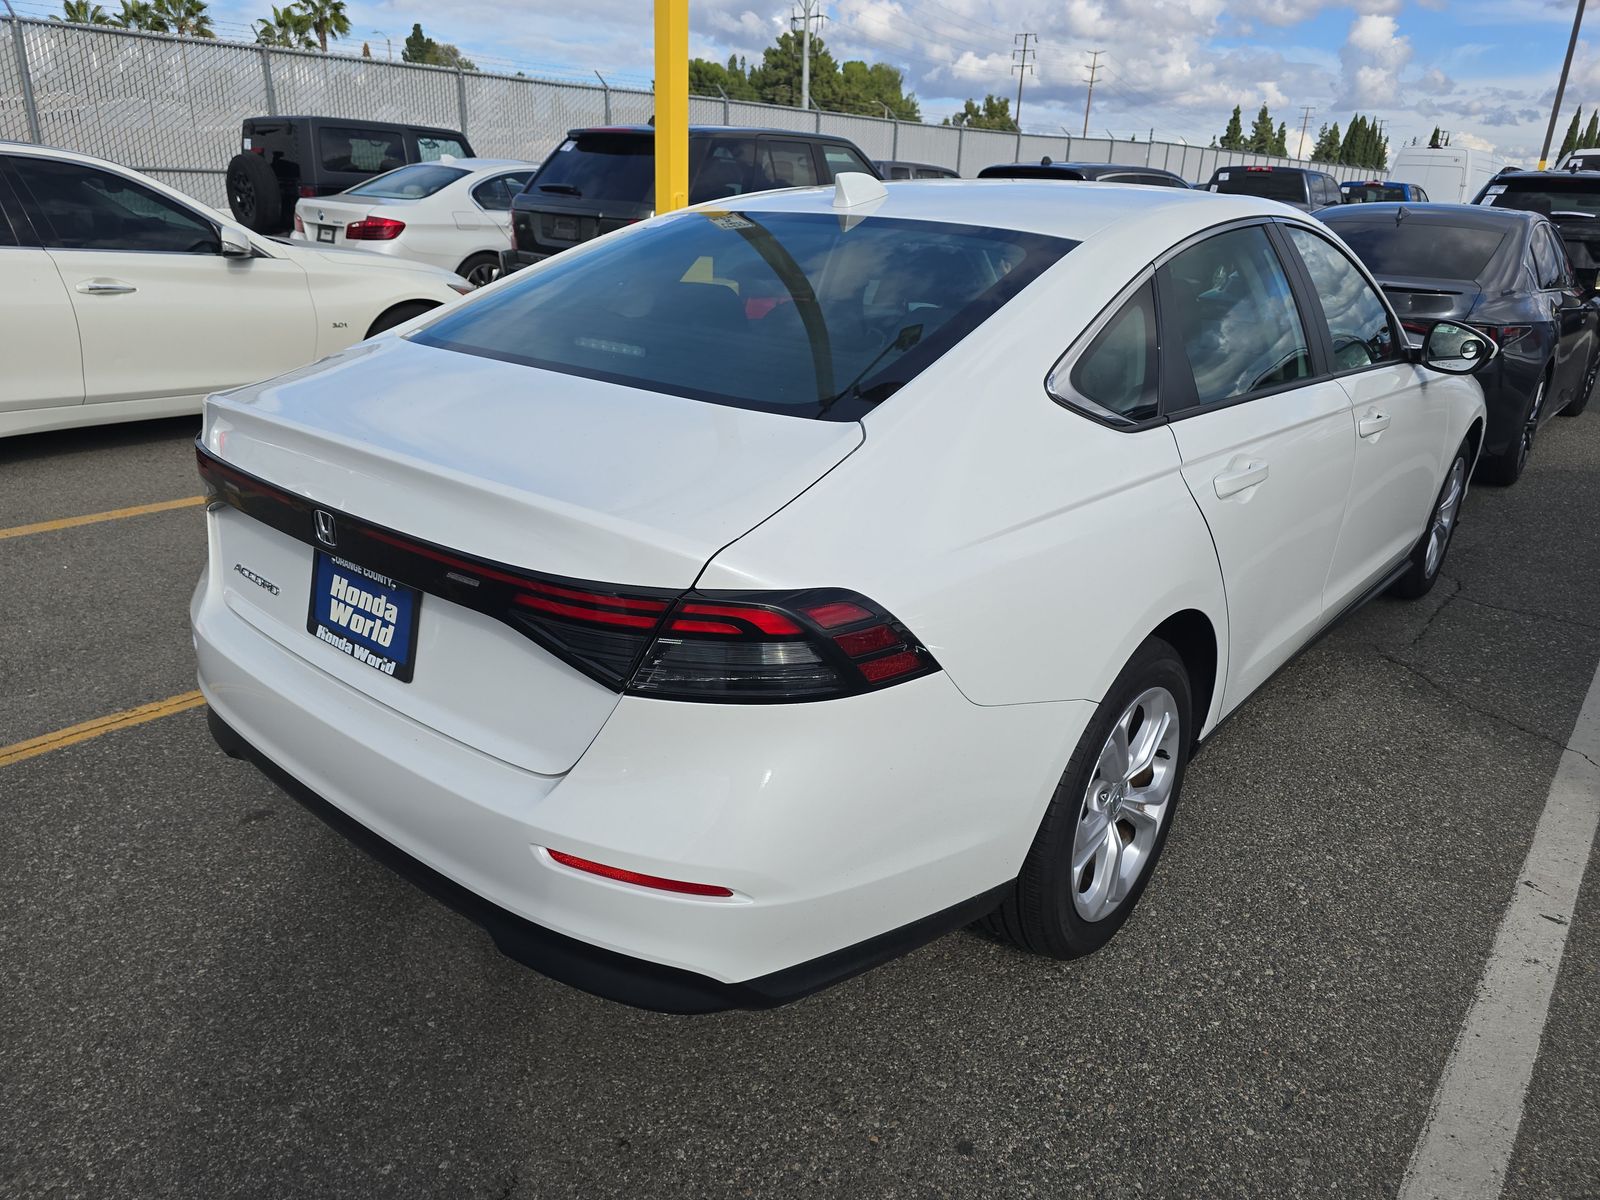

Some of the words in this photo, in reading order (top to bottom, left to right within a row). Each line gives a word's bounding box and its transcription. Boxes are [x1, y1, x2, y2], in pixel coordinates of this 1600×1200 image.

[233, 563, 280, 596] ACCORD
[330, 574, 398, 624] Honda
[363, 567, 392, 587] COUNTY
[330, 598, 395, 648] World
[316, 624, 353, 655] Honda
[353, 643, 396, 675] World
